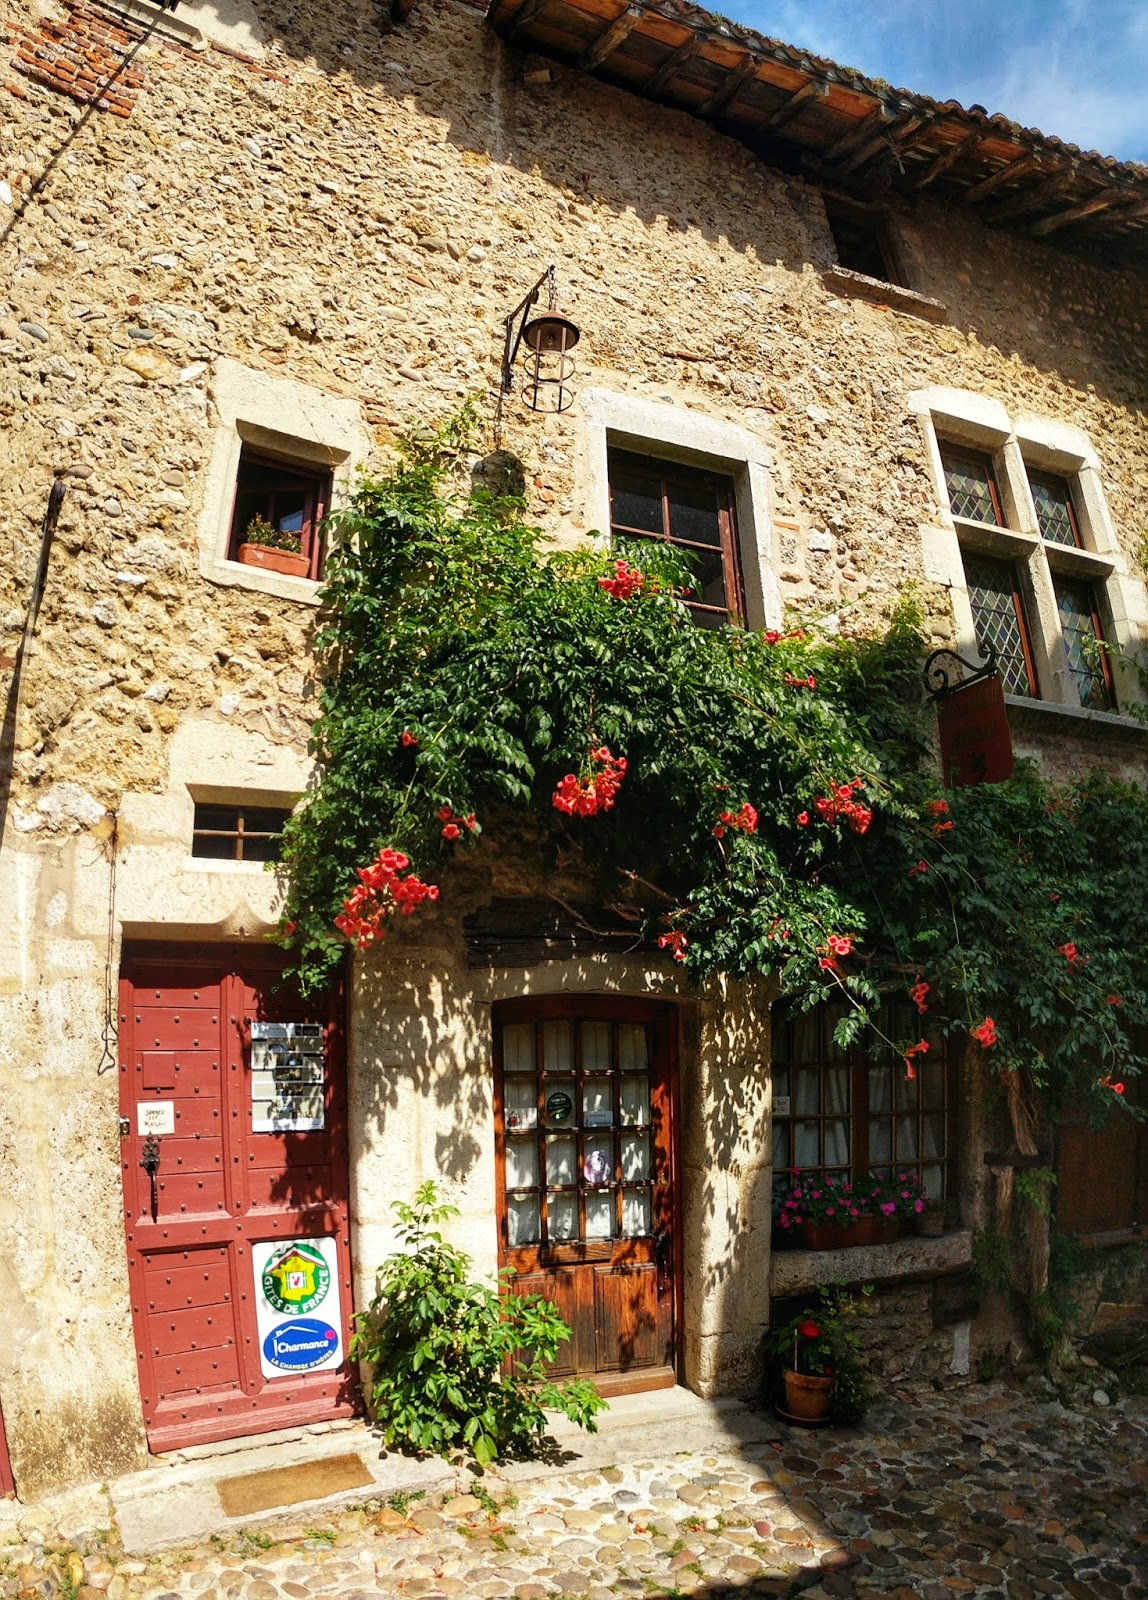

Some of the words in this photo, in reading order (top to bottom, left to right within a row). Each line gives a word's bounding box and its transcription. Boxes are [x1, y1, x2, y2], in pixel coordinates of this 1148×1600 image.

[283, 1304, 299, 1314] DE
[302, 1269, 329, 1313] FRANCE
[277, 1340, 329, 1354] Charmance
[270, 1357, 279, 1366] LA
